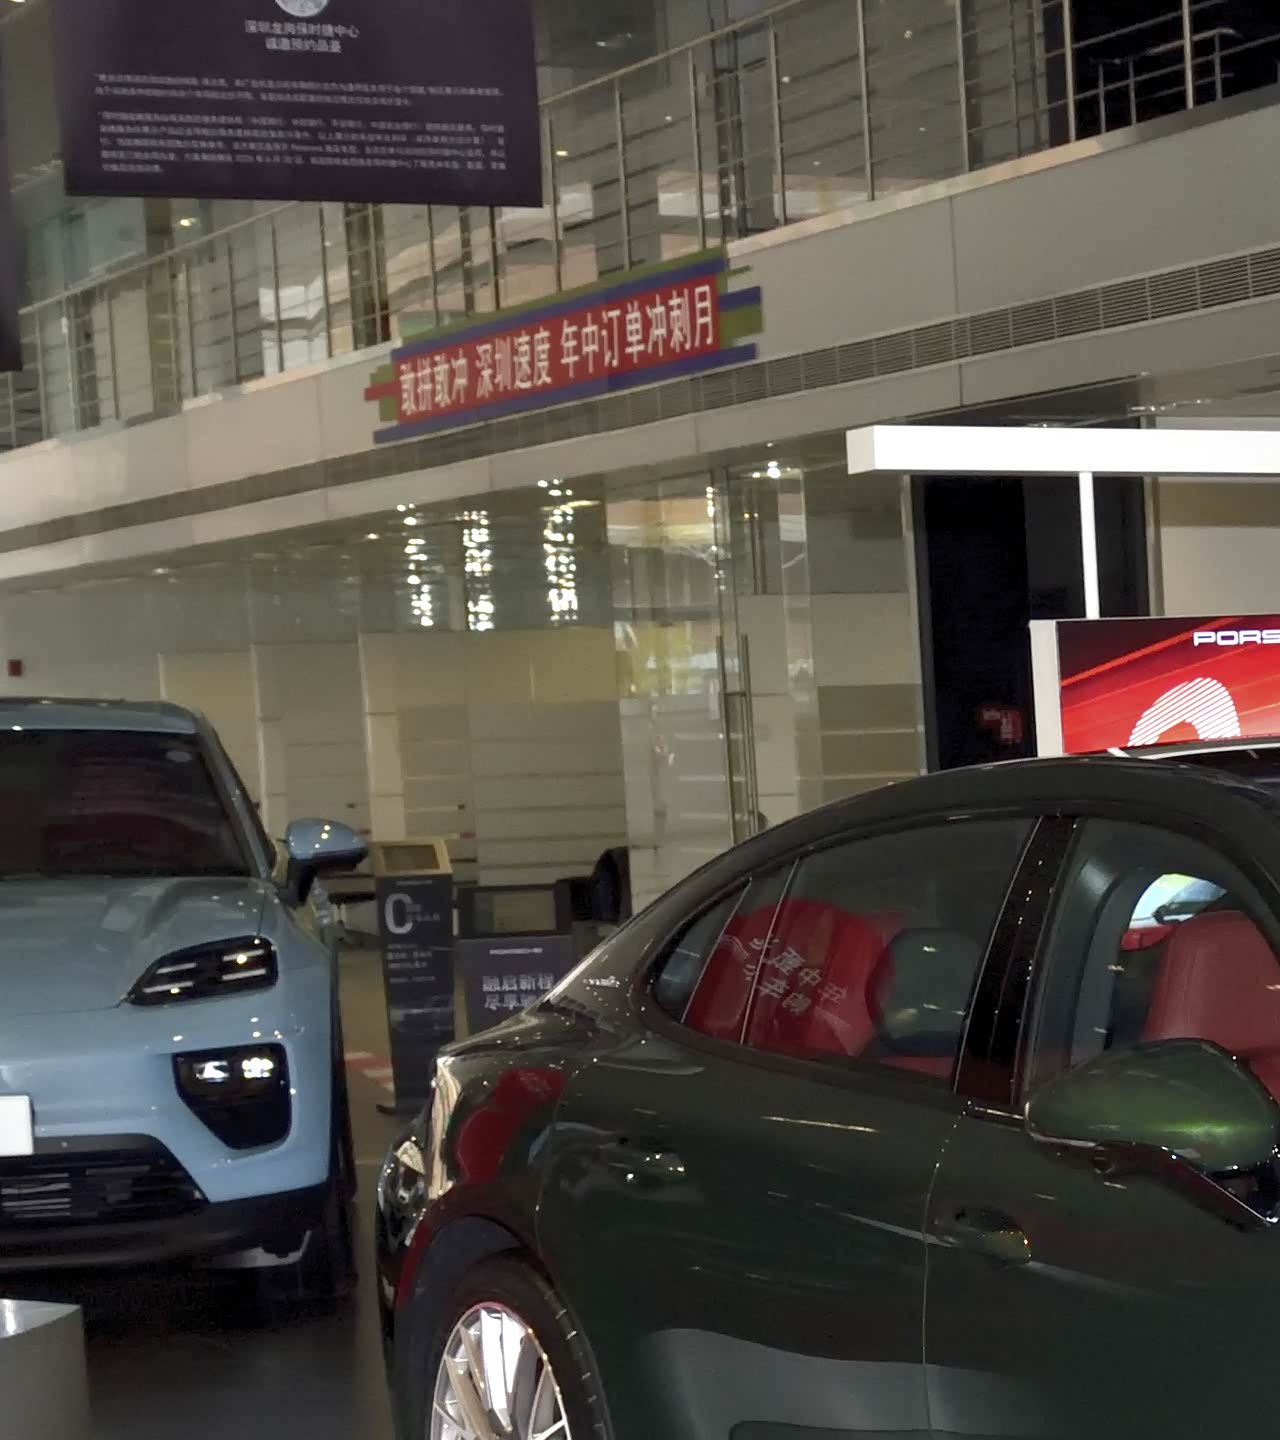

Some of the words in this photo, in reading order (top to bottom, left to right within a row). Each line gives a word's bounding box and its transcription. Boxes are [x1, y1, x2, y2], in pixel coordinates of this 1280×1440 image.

[400, 348, 467, 416] 敢拼敢冲
[476, 326, 552, 398] 深圳速度
[560, 284, 715, 378] 年中订单冲刺月
